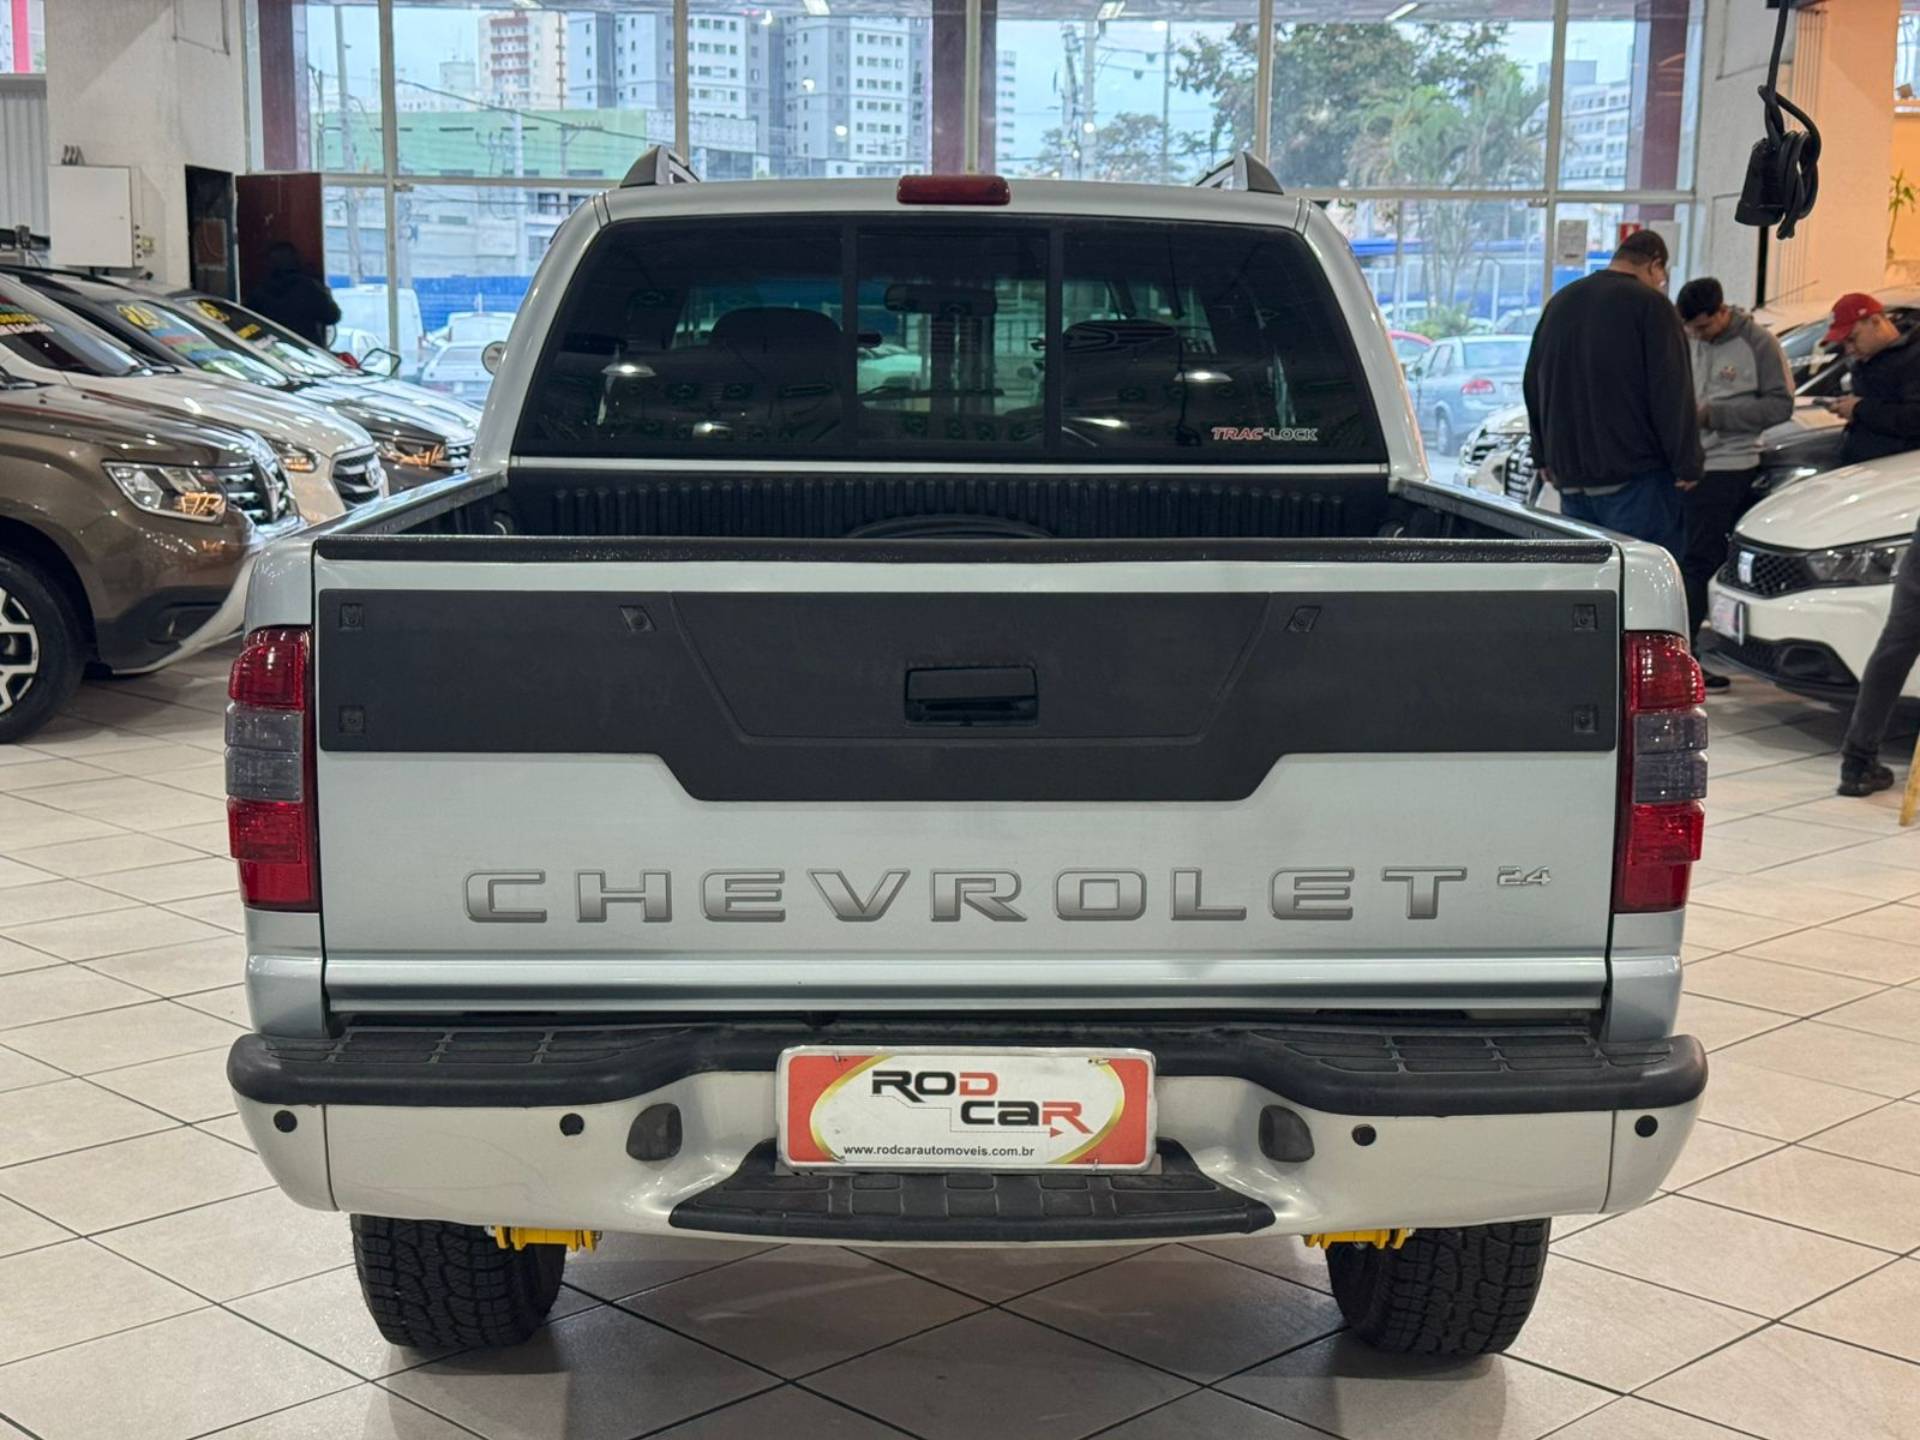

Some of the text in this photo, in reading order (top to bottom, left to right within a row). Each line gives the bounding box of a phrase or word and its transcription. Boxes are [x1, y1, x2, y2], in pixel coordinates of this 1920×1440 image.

[1211, 426, 1318, 441] TRAC-LOCK
[463, 867, 1467, 923] CHEVROLET
[872, 1070, 998, 1103] ROD
[843, 1144, 1035, 1158] www.rodcarautomoveis.com.br
